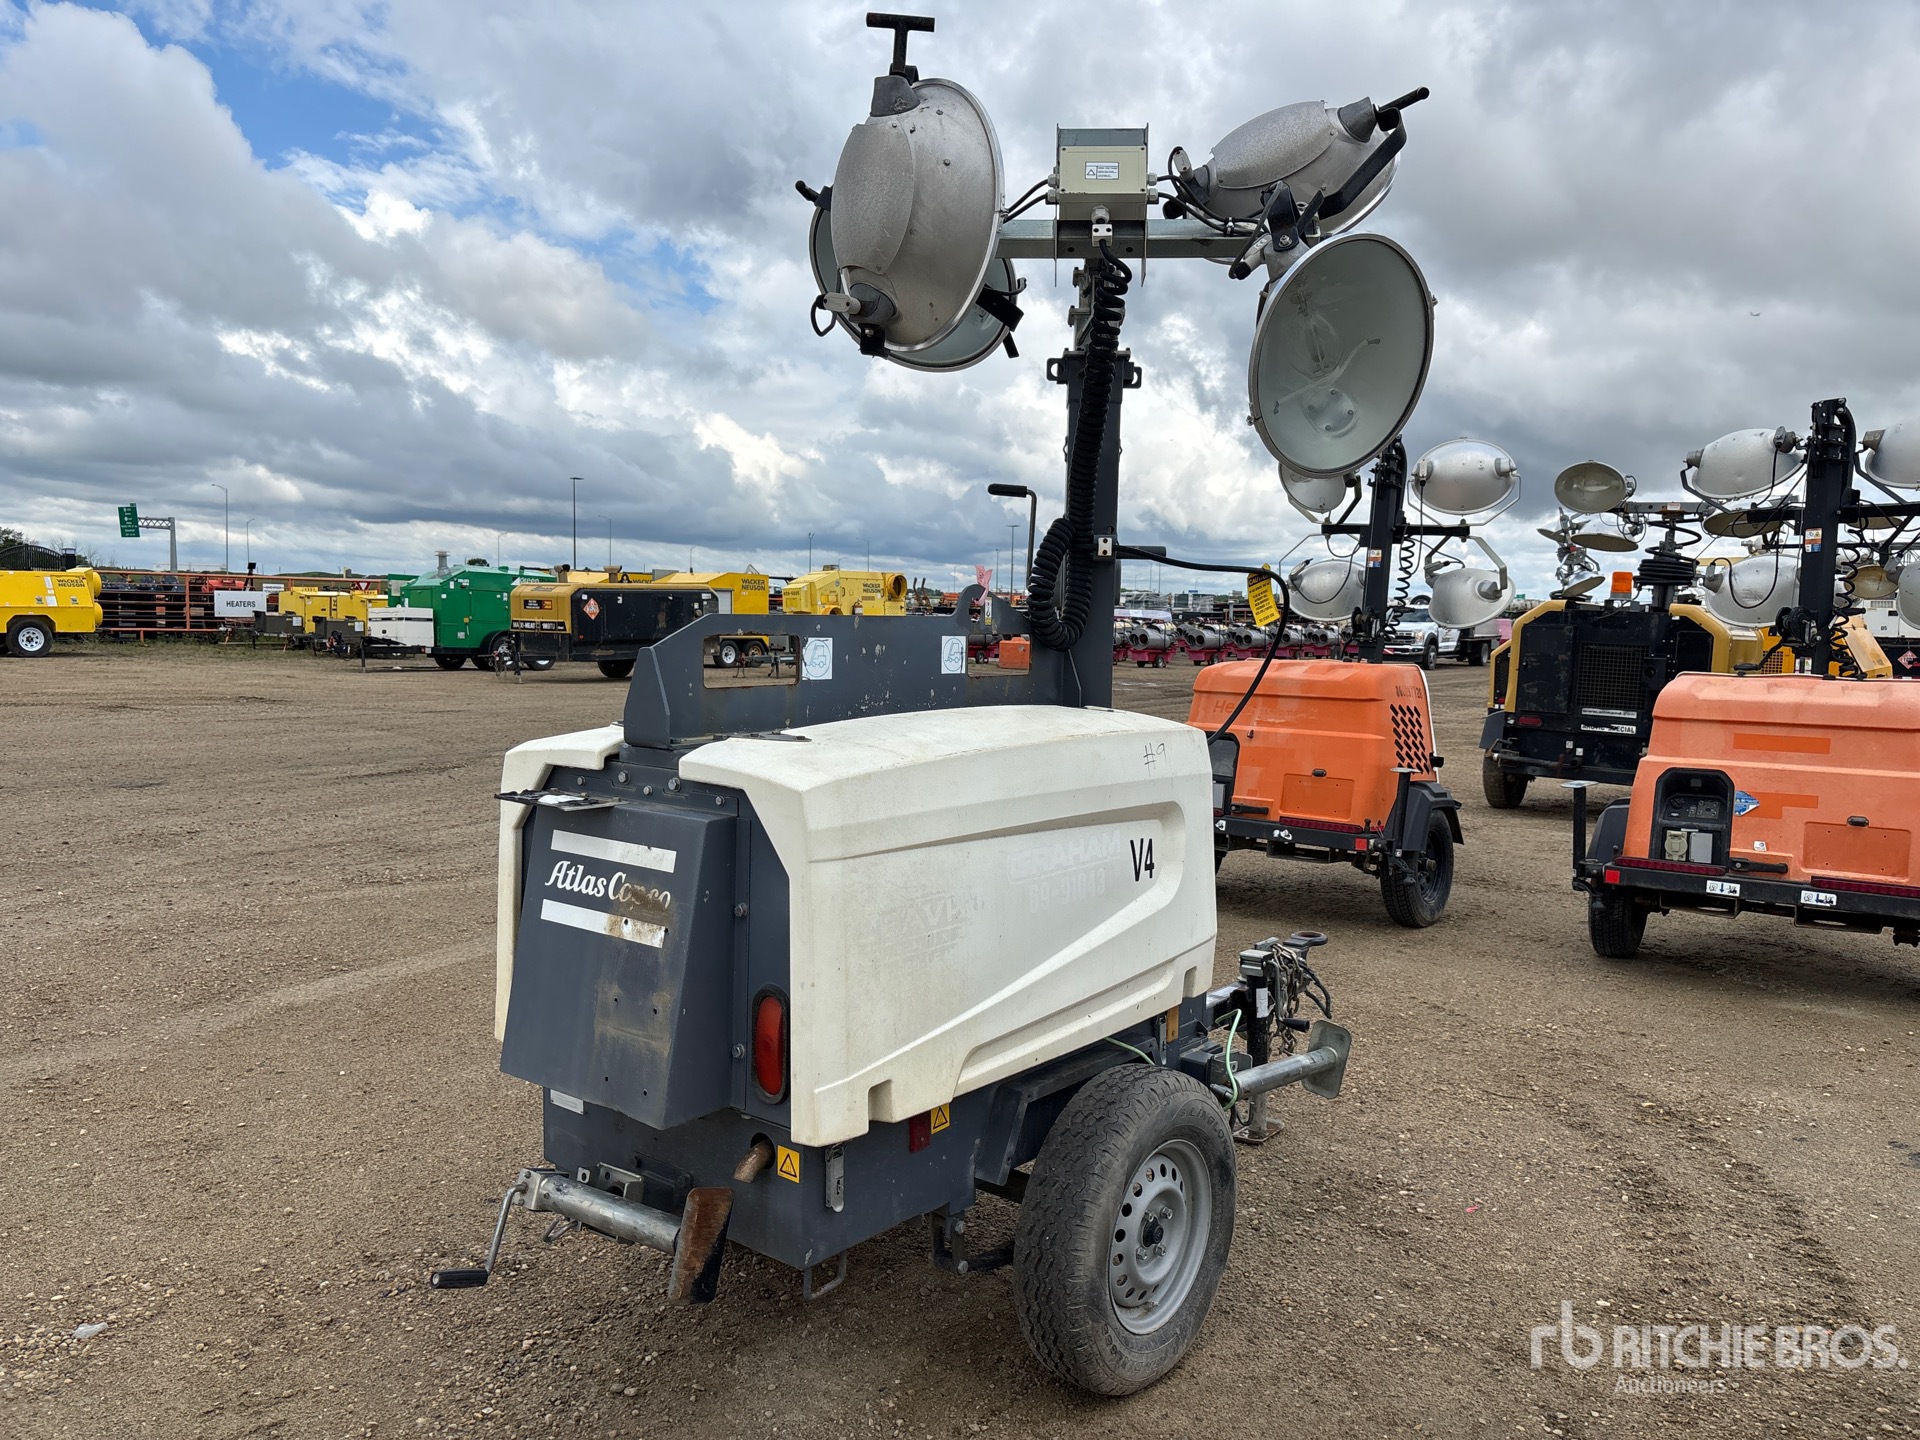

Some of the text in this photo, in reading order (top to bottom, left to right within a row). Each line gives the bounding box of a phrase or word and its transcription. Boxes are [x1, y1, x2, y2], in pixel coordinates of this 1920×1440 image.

[226, 600, 256, 608] HEATERS
[545, 860, 607, 898] Atlas
[1129, 838, 1155, 882] V4
